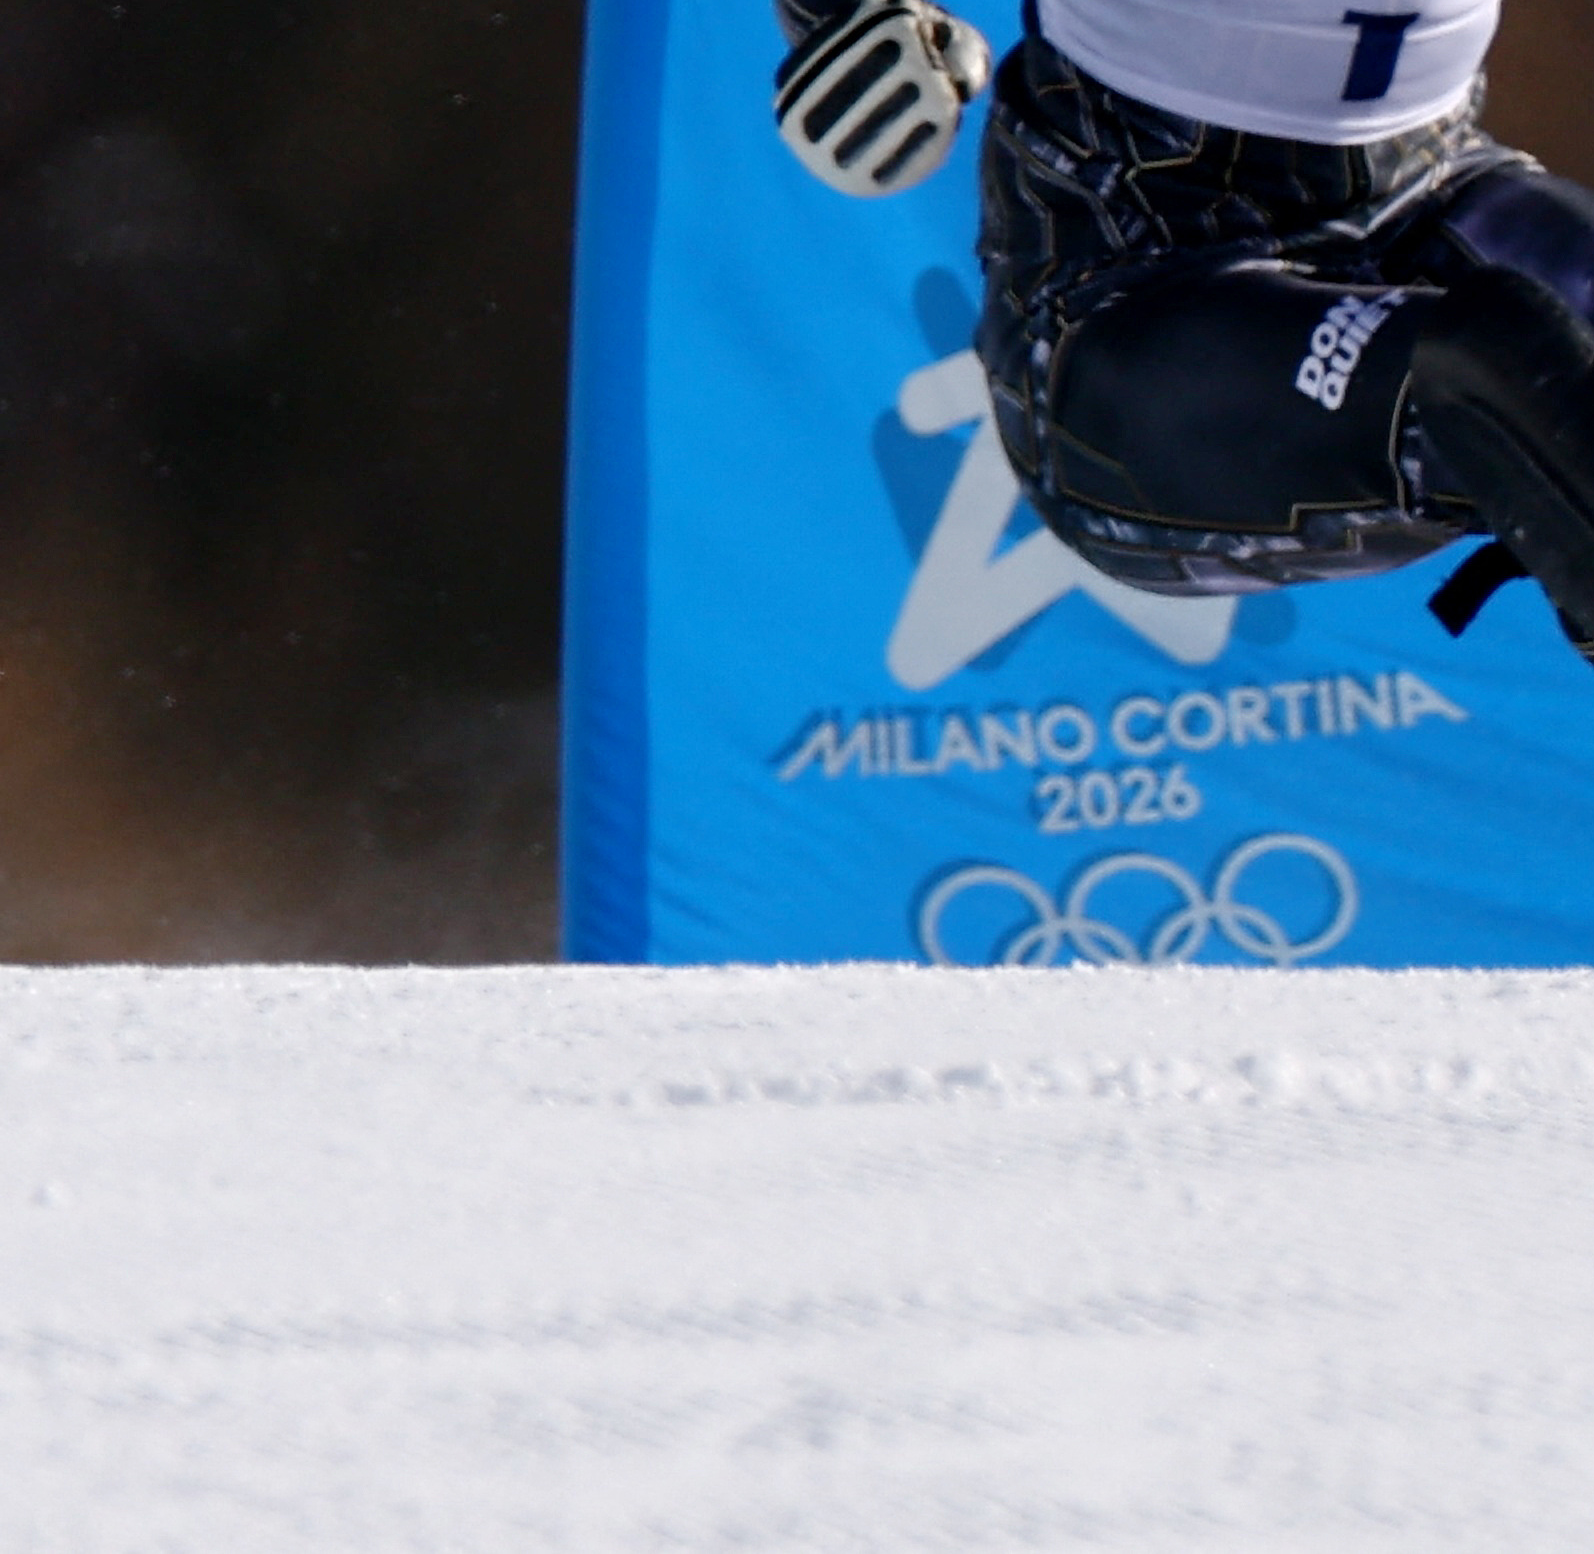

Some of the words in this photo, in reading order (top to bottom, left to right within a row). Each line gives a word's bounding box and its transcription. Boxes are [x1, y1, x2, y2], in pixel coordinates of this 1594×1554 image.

[1341, 9, 1421, 102] 1
[1295, 295, 1366, 400] DON
[1321, 287, 1406, 411] QUIET
[777, 703, 1098, 783] MILANO
[1110, 670, 1468, 758] CORTINA
[1036, 764, 1202, 834] 2026
